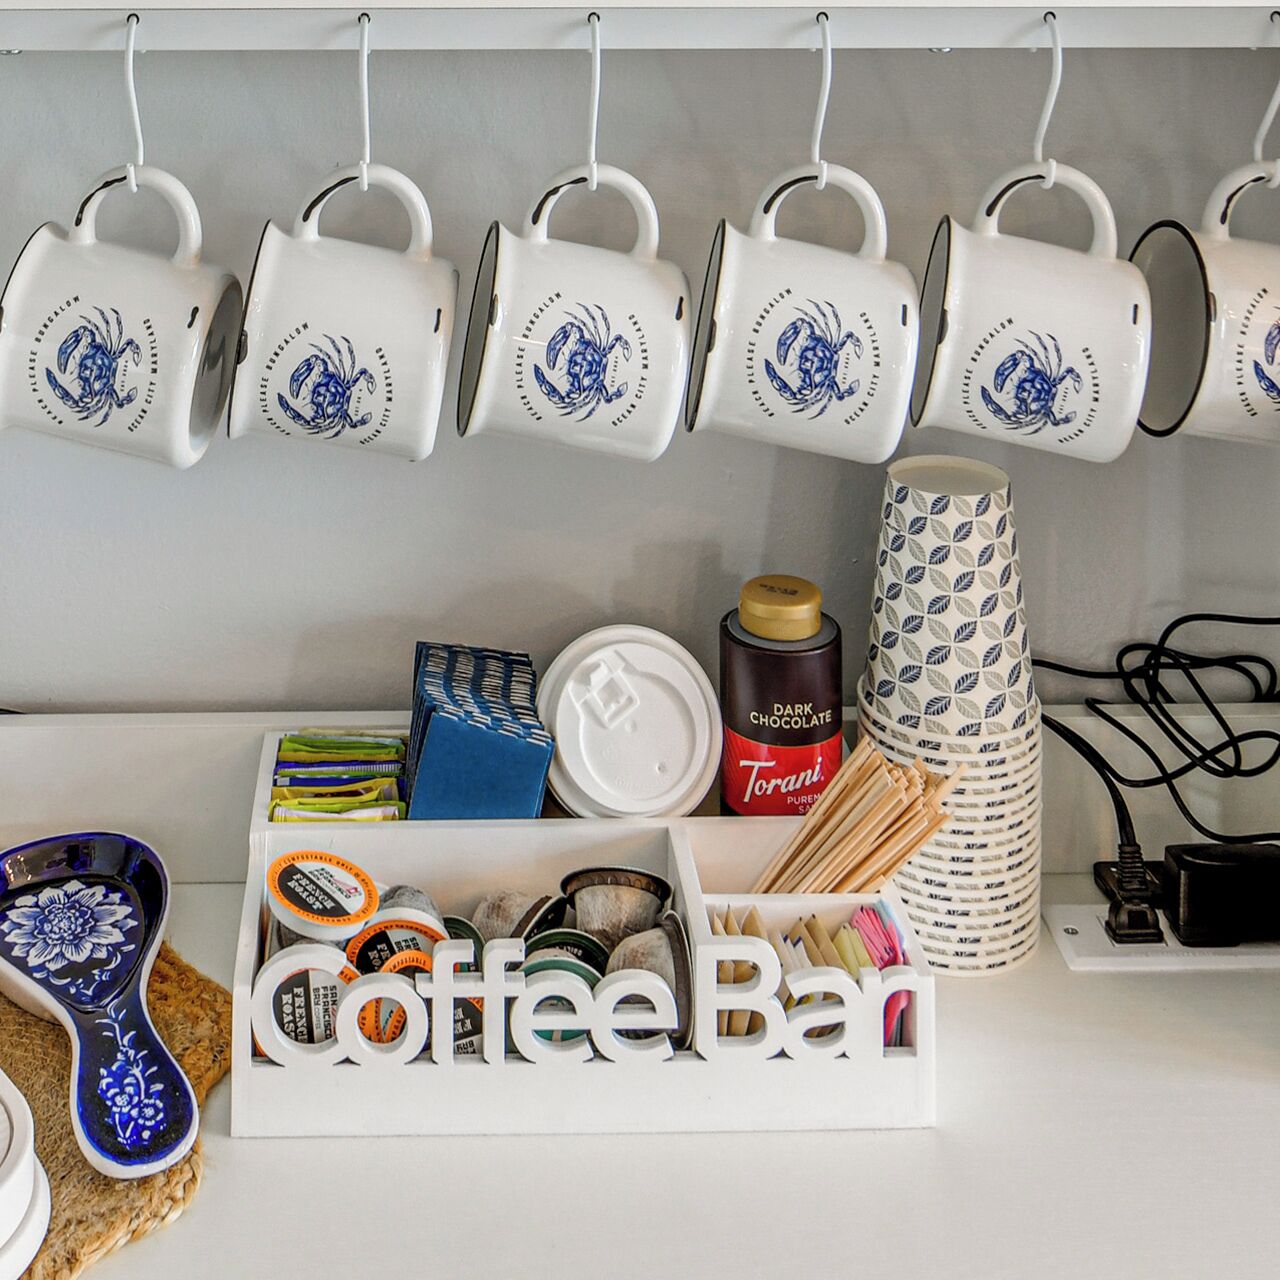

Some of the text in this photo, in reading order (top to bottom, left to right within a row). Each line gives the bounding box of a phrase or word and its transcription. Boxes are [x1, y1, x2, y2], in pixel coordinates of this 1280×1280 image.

[29, 351, 38, 393] PLEASE
[35, 296, 80, 343] BUNGALOW
[516, 347, 525, 389] PLEASE
[523, 292, 562, 339] BUNGALOW
[747, 341, 756, 383] PLEASE
[753, 288, 792, 334] BUNGALOW
[962, 369, 973, 405] PLEASE
[971, 318, 1014, 363] BUNGALOW
[128, 319, 157, 432] OCEAN CITY MARYLAND
[260, 377, 269, 413] PLEASE
[266, 322, 309, 370] BUNGALOW
[376, 347, 392, 401] MARYLAND
[612, 314, 648, 426] OCEAN CITY MARYLAND
[844, 312, 880, 424] OCEAN CITY MARYLAND
[1082, 347, 1099, 402] MARYLAND
[1236, 344, 1244, 385] PLEASE
[380, 408, 391, 427] CITY
[1084, 408, 1097, 427] CITY
[750, 710, 832, 729] CHOCOLATE
[773, 703, 813, 717] DARK
[739, 757, 822, 803] Torani
[287, 880, 323, 910] ROAST
[292, 873, 335, 910] FRENCH
[249, 935, 918, 1066] Coffee Bar
[312, 988, 320, 1005] BAY
[321, 986, 332, 1039] FRANCISCO
[329, 985, 338, 1006] SAN
